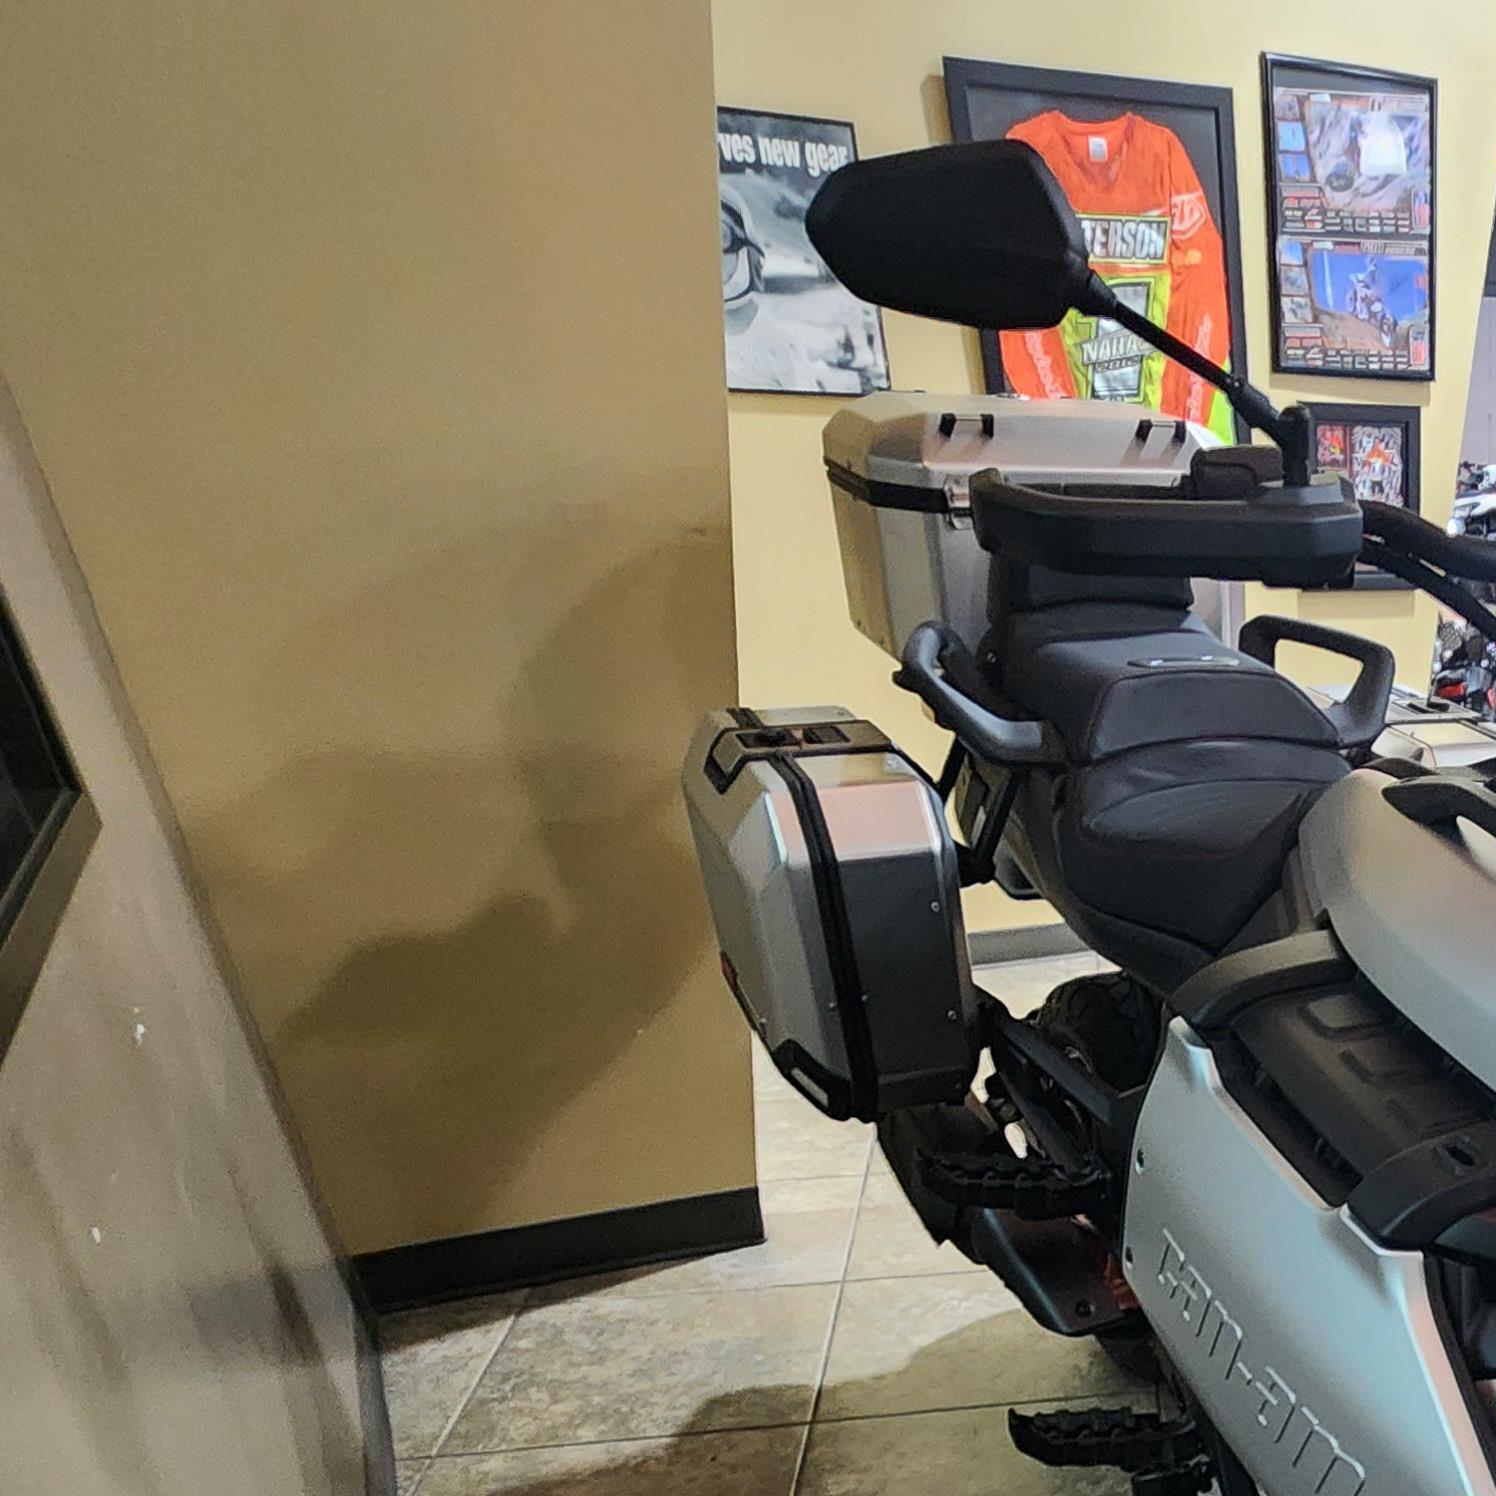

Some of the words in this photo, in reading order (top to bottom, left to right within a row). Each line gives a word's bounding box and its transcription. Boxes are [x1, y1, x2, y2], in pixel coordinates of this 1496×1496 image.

[718, 132, 757, 164] ves
[757, 135, 800, 168] new
[804, 141, 849, 178] gear
